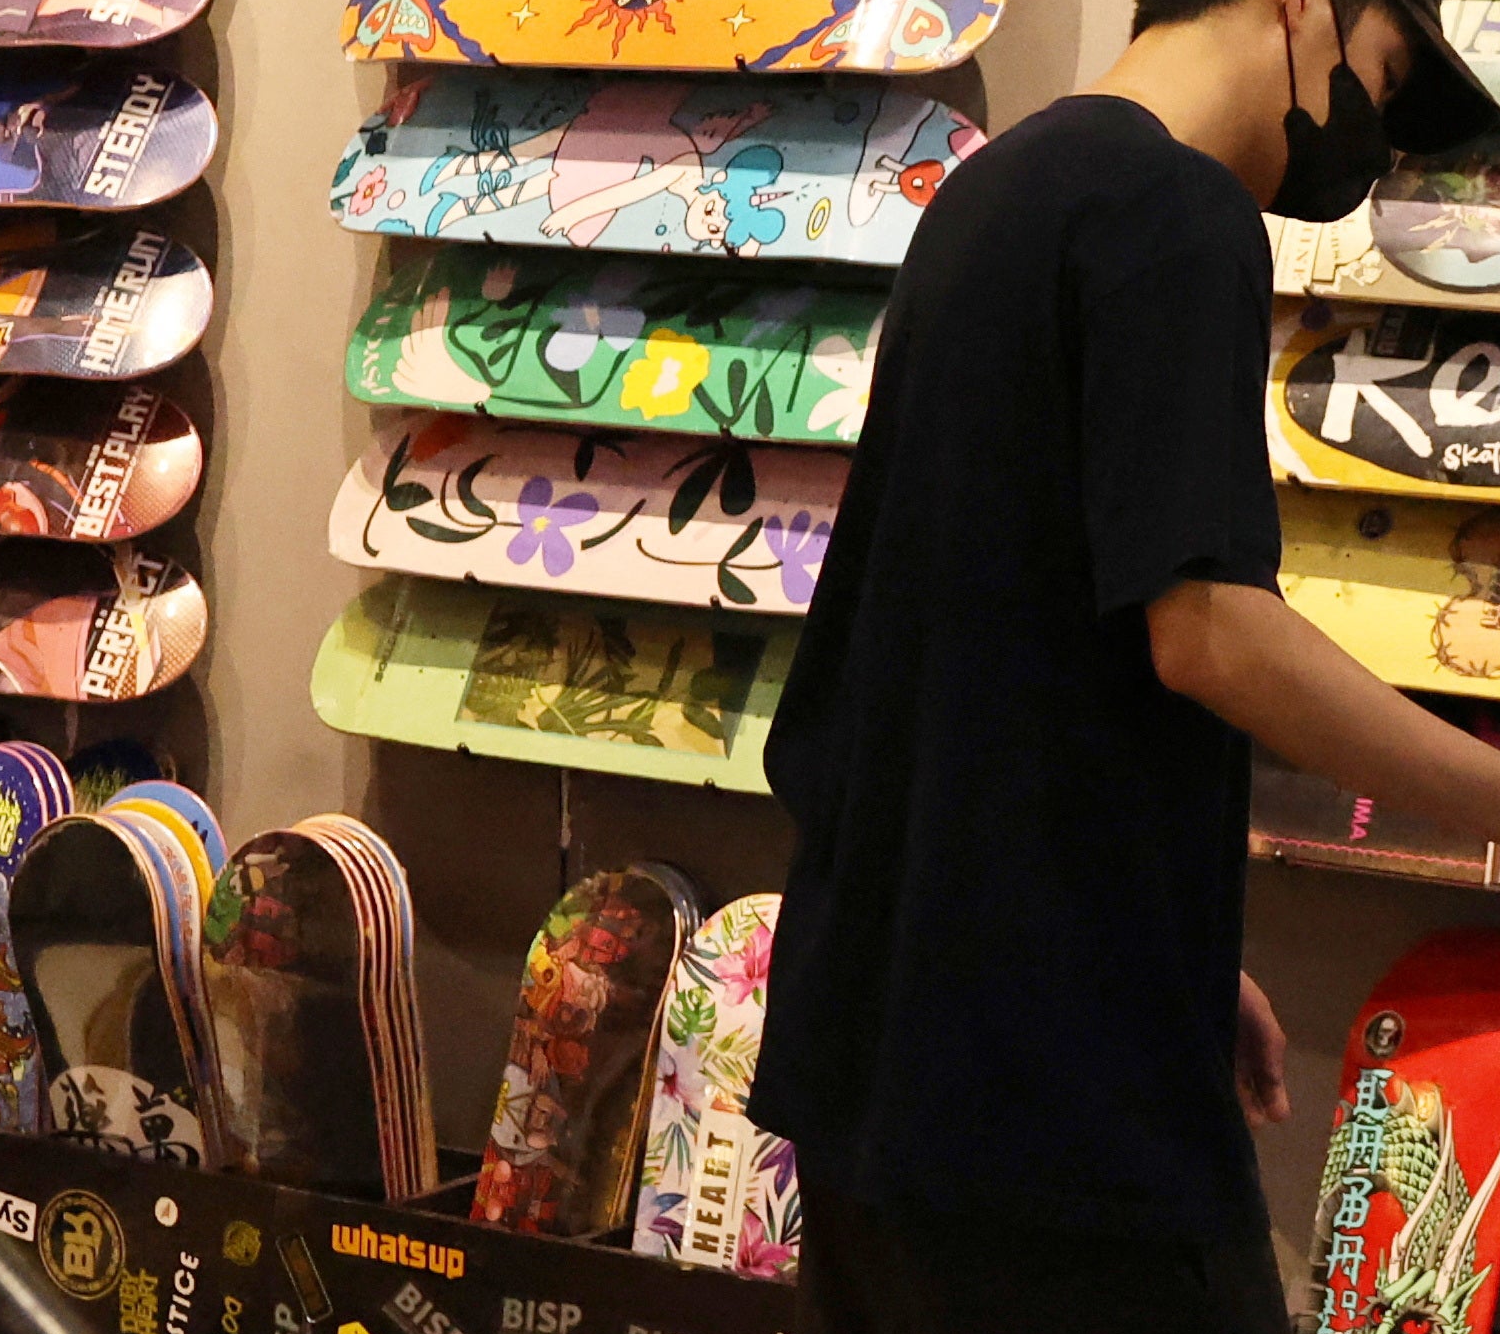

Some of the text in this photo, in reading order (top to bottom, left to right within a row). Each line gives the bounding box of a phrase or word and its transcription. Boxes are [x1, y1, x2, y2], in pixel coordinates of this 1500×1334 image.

[86, 73, 167, 199] STEADY
[80, 297, 136, 373] HOME
[692, 1131, 736, 1257] HEART
[331, 1223, 465, 1280] whatsup
[222, 1294, 244, 1330] DO
